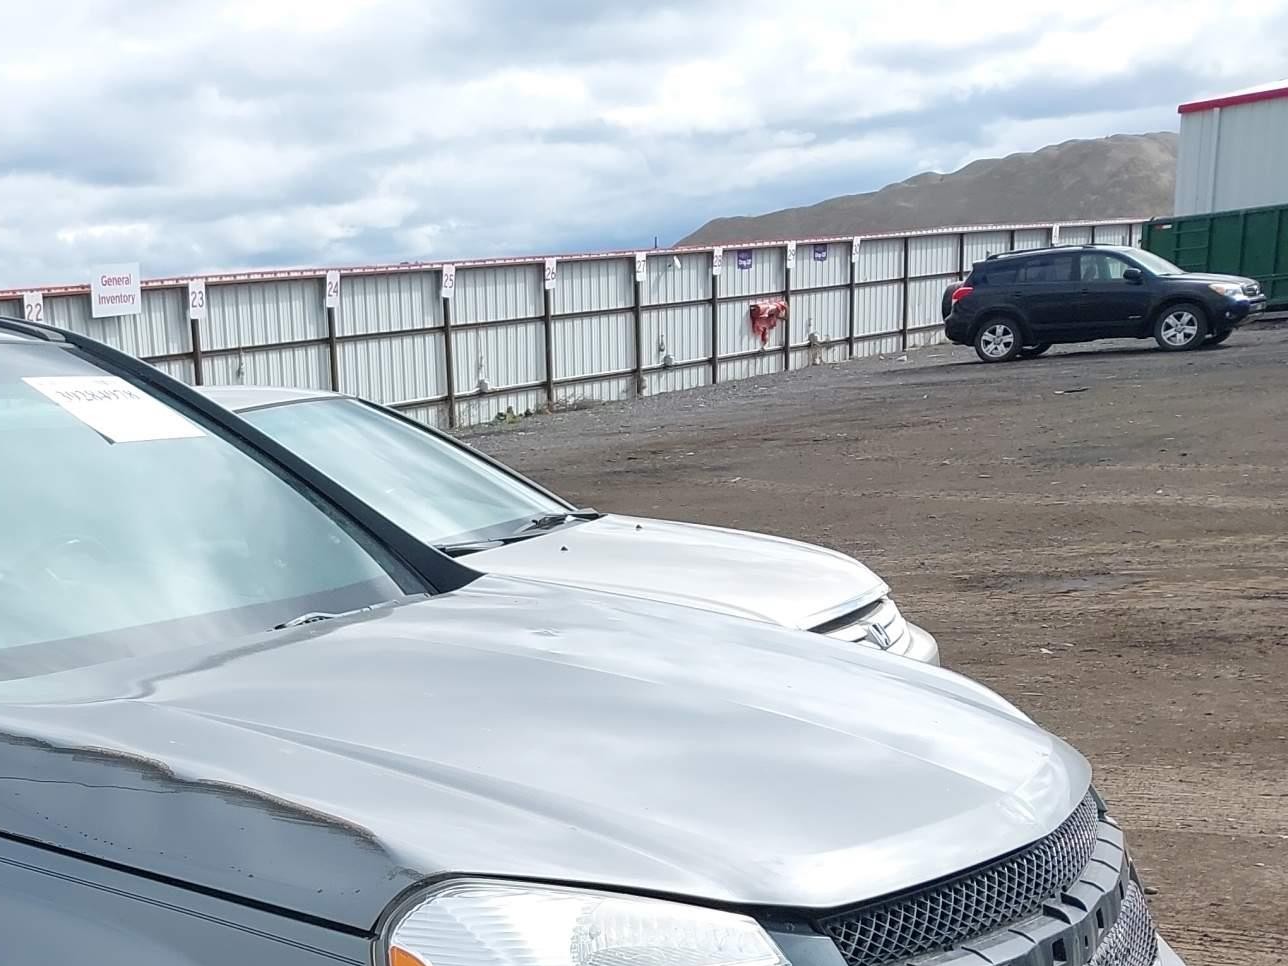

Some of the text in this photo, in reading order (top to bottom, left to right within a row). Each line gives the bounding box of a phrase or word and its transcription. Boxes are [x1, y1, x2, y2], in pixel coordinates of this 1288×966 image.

[100, 274, 132, 287] General
[444, 273, 454, 289] 25
[546, 267, 557, 281] 26
[327, 281, 339, 297] 24
[98, 293, 136, 305] Inventory
[191, 291, 204, 308] 23
[26, 303, 42, 322] 22
